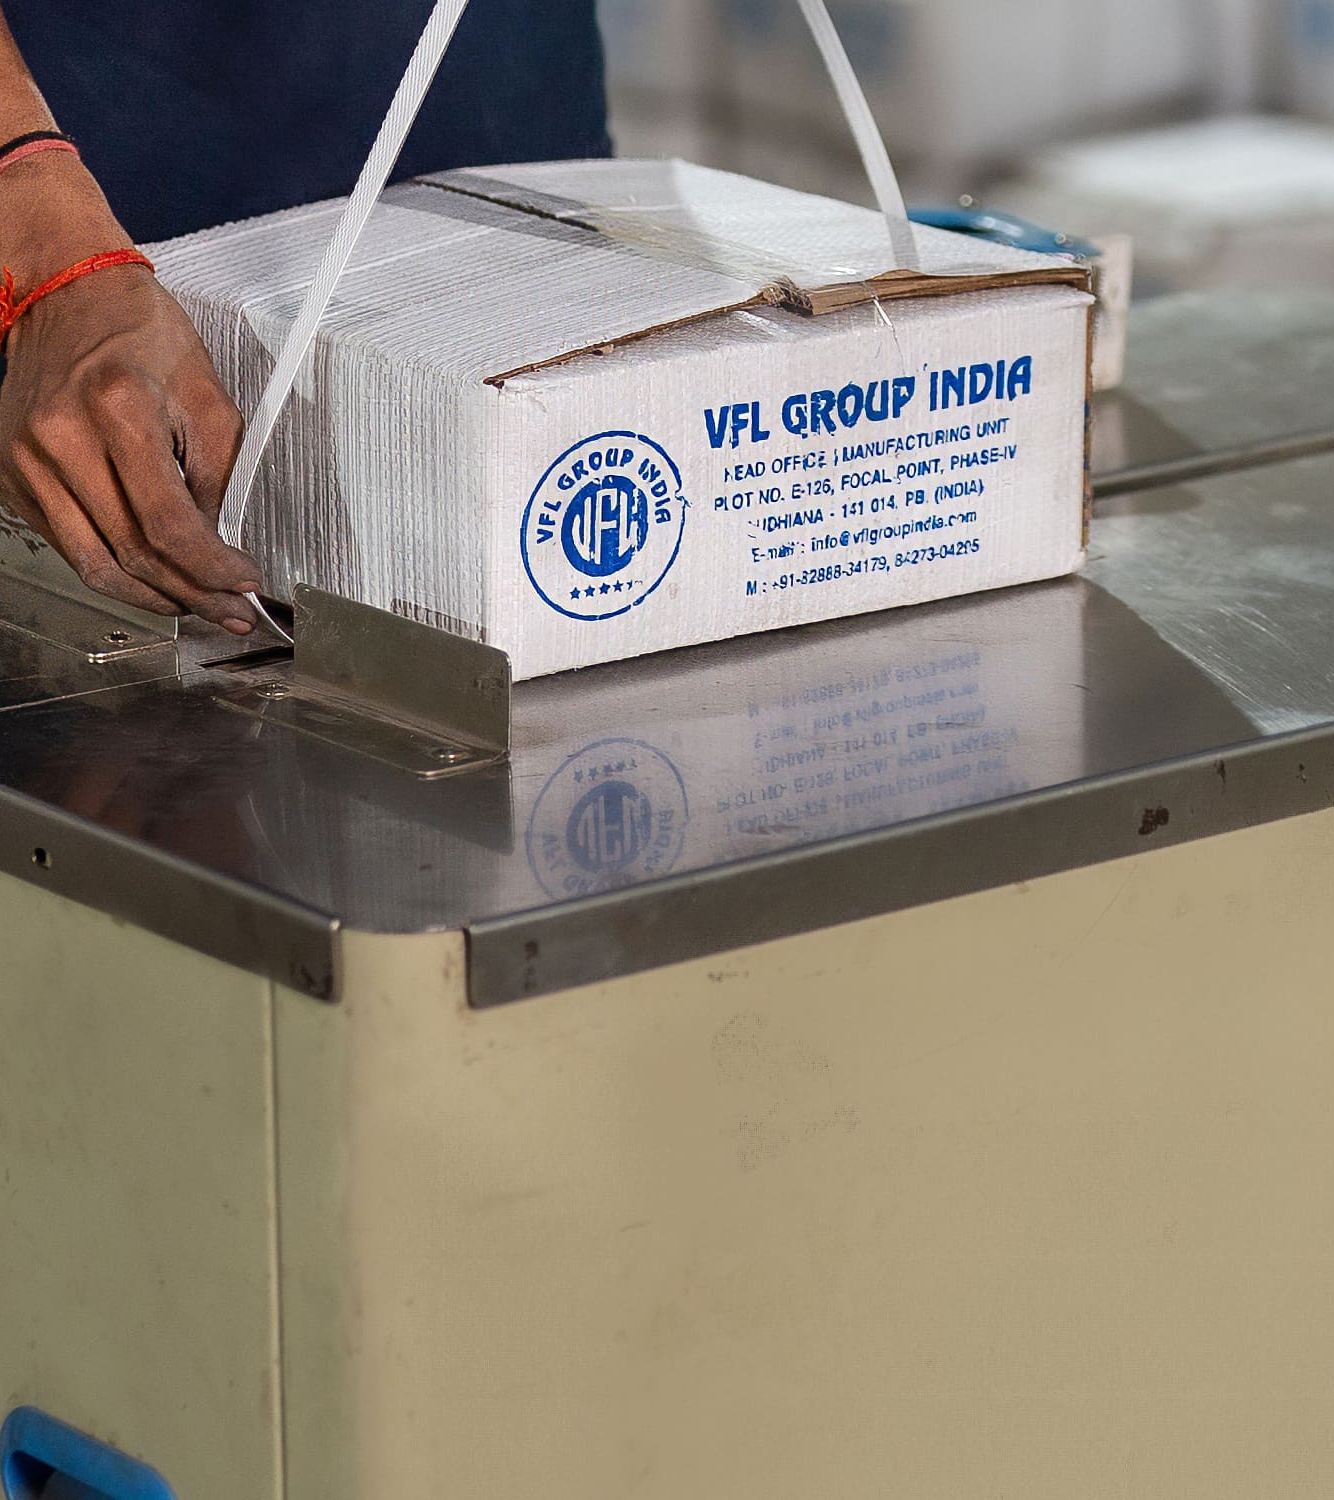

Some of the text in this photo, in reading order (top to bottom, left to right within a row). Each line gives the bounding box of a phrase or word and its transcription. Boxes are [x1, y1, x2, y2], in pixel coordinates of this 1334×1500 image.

[704, 355, 1032, 449] VFL GROUP INDIA
[714, 445, 1017, 511] PLOT NO. E-126, FOCAL POINT, PHASE-IV
[771, 450, 827, 473] OFFICE
[842, 425, 971, 462] MANUFACTURING
[976, 417, 1010, 438] UNIT
[536, 448, 671, 544] VFL GROUP INDIA
[571, 487, 639, 565] VFL
[748, 508, 823, 532] UDHIANA
[935, 479, 985, 504] (INDIA)
[746, 580, 757, 596] M
